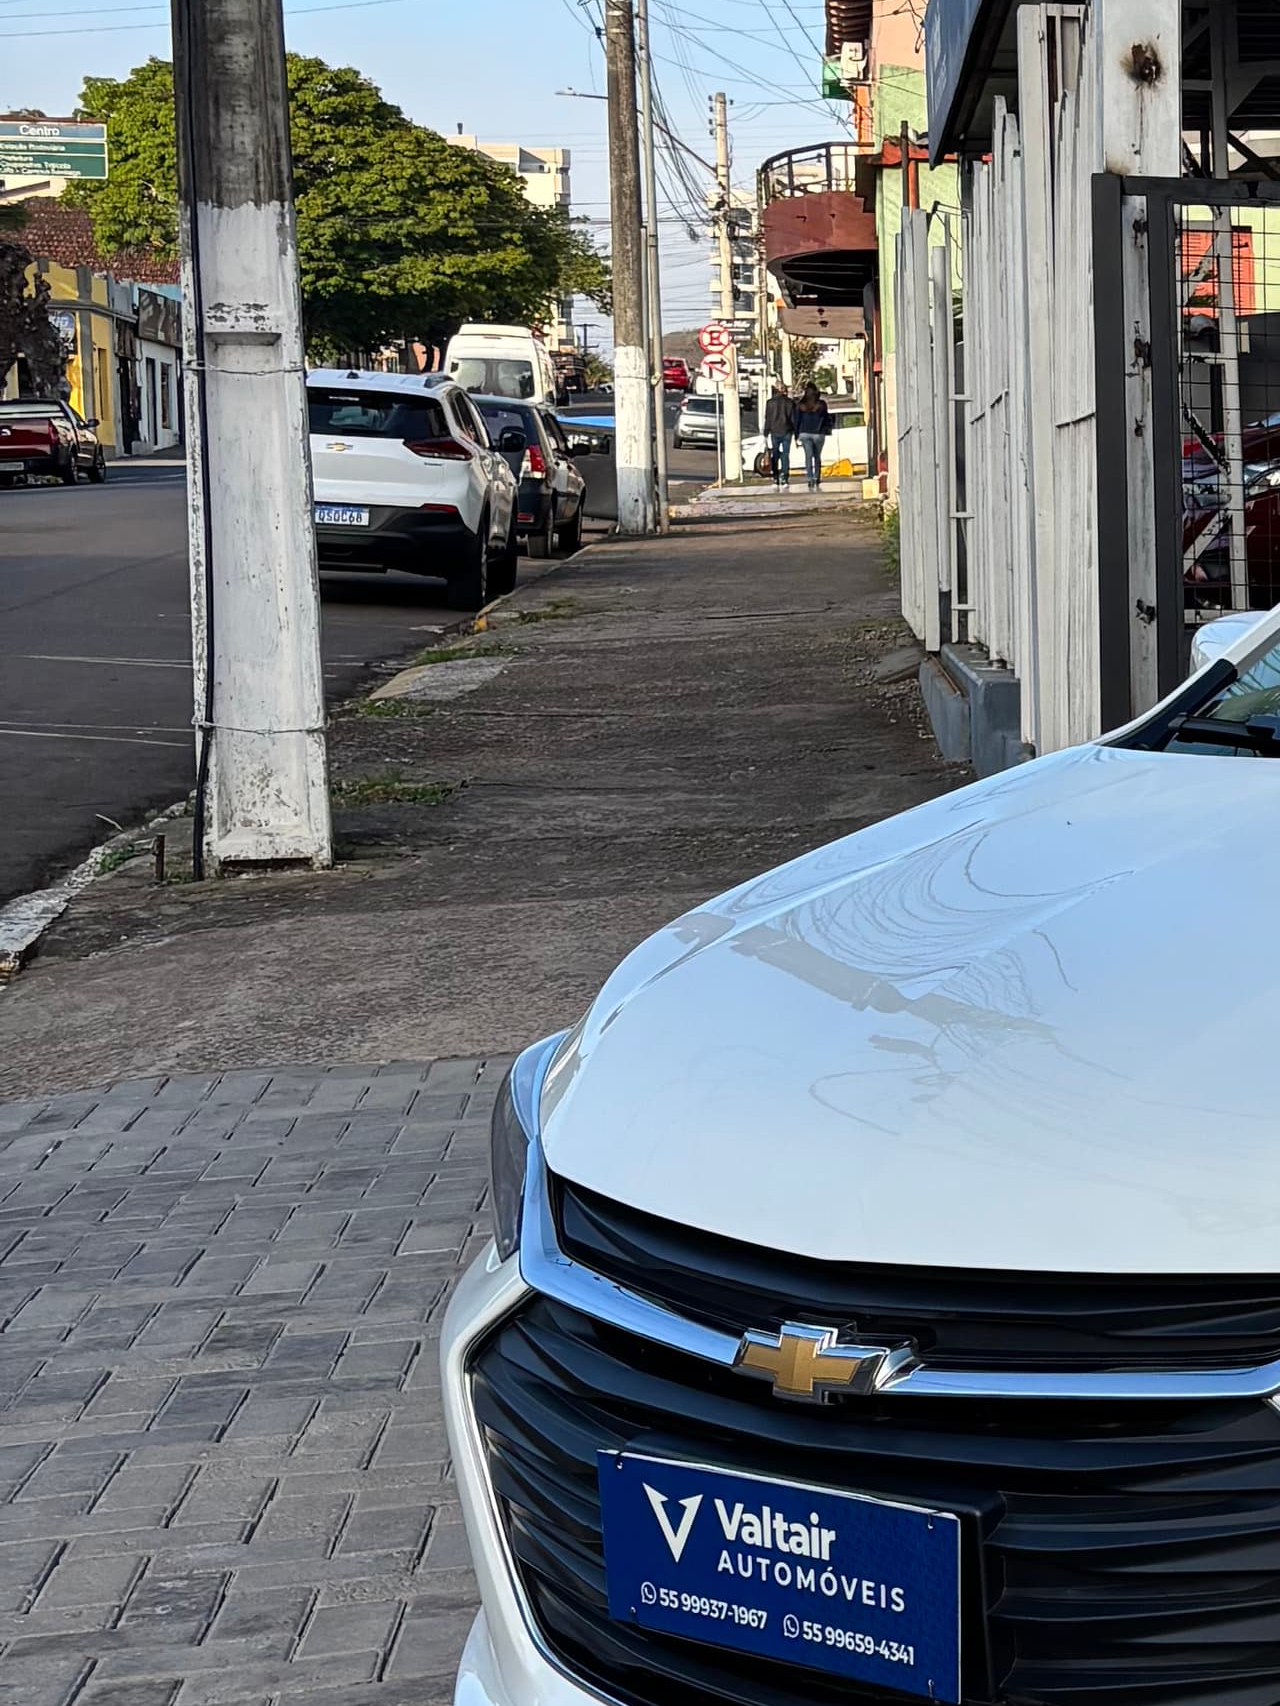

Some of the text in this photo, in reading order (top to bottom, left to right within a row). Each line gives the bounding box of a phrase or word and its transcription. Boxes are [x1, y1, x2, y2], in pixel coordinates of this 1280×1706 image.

[19, 125, 60, 136] Centro
[714, 1498, 837, 1561] Valtair
[717, 1550, 906, 1612] AUTOMÓVEIS
[660, 1588, 769, 1630] 55 99937-1967
[803, 1620, 914, 1665] 55 99659-4341
